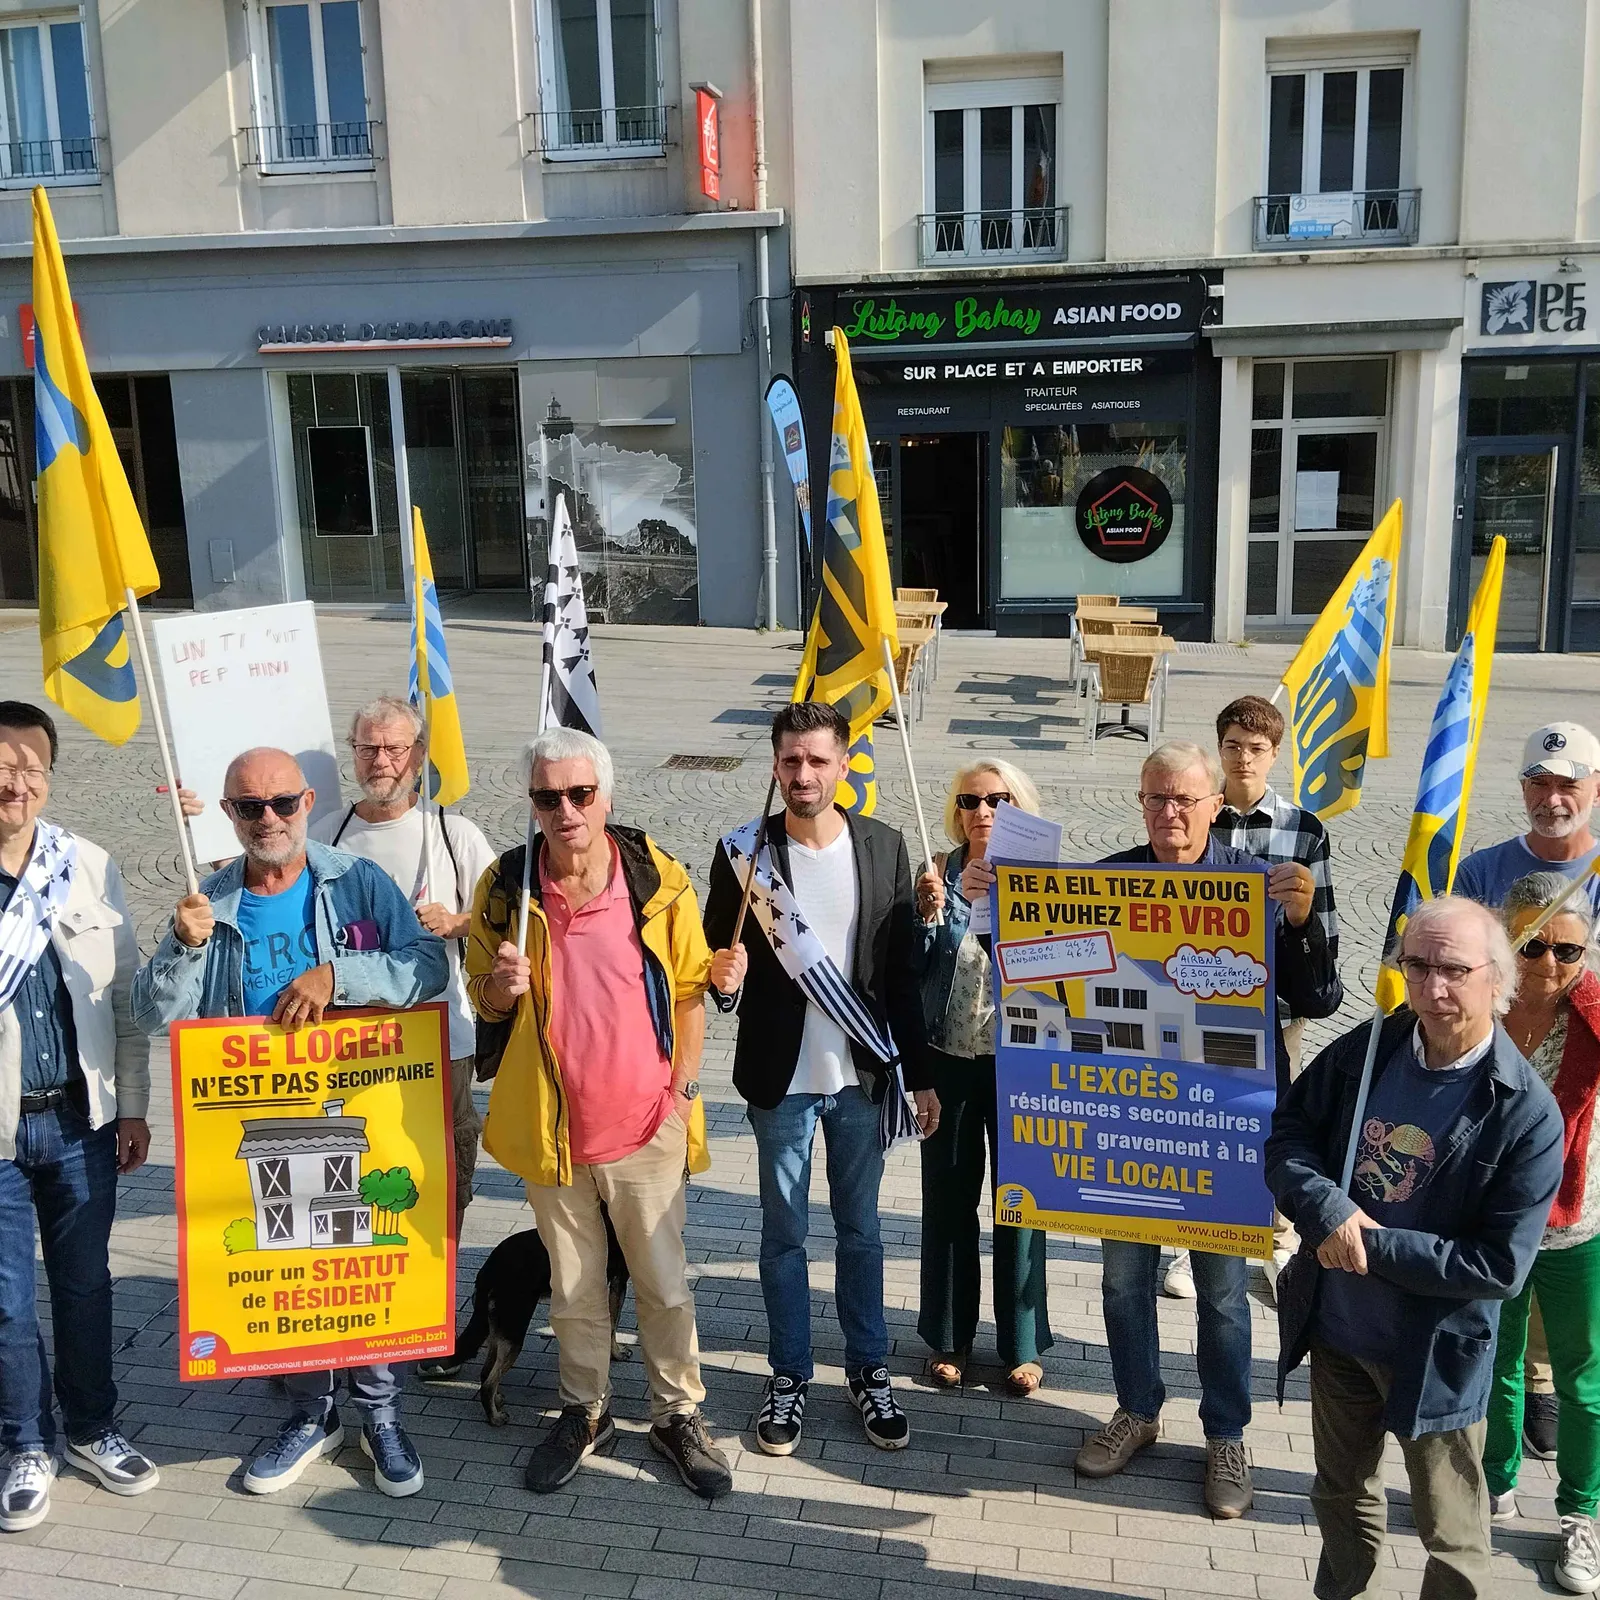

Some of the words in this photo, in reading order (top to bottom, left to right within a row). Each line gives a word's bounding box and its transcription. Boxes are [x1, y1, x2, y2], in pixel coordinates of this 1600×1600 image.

[846, 300, 945, 340] Lutong
[955, 297, 1042, 340] Bahay
[1053, 304, 1115, 325] ASIAN
[1121, 302, 1181, 322] FOOD
[256, 323, 347, 344] CAISSE
[903, 366, 936, 381] SUR
[945, 362, 997, 379] PLACE
[1005, 362, 1025, 377] ET
[1033, 361, 1045, 376] A
[1053, 358, 1143, 375] EMPORTER
[1024, 386, 1077, 398] TRAITEUR
[897, 406, 951, 416] RESTAURANT
[1024, 400, 1083, 412] SPECIALITÉES
[1091, 400, 1141, 411] ASIATIQUES
[1084, 507, 1125, 529] Lutong
[1129, 503, 1165, 530] Bahay
[171, 638, 206, 663] UN
[219, 632, 246, 652] TI
[189, 667, 229, 687] PEP
[248, 660, 289, 677] HINI
[1008, 874, 1039, 894] RE
[1044, 875, 1060, 895] A
[1066, 876, 1101, 896] EIL
[1105, 877, 1156, 898] TIEZ
[1162, 880, 1178, 899] A
[1183, 879, 1250, 903] VOUG
[1009, 901, 1040, 923] AR
[1046, 903, 1121, 927] VUHEZ
[1129, 902, 1172, 934] ER
[1180, 905, 1250, 938] VRO
[1181, 980, 1200, 988] dans
[1205, 978, 1216, 989] le
[1220, 976, 1265, 988] Finistère
[222, 1034, 270, 1068] SE
[286, 1022, 404, 1066] LOGER
[192, 1074, 264, 1098] N'EST
[272, 1071, 319, 1094] PAS
[327, 1062, 434, 1089] SECONDAIRE
[1051, 1063, 1179, 1100] L'EXCÈS
[1189, 1084, 1215, 1103] de
[1009, 1091, 1121, 1118] résidences
[1128, 1106, 1261, 1133] secondaires
[1012, 1114, 1088, 1150] NUIT
[1097, 1131, 1210, 1159] gravement
[1217, 1140, 1230, 1161] à
[1238, 1143, 1258, 1164] la
[1052, 1152, 1095, 1182] VIE
[1106, 1158, 1213, 1196] LOCALE
[1000, 1209, 1022, 1224] UDB
[1024, 1218, 1047, 1227] UNION
[1049, 1220, 1103, 1235] DÉMOCRATIQUE
[1104, 1228, 1141, 1240] BRETONNE
[1151, 1234, 1191, 1246] UNVANIEZH
[1192, 1240, 1239, 1253] DEMOKRATEL
[1241, 1246, 1265, 1256] BREIZH
[1177, 1224, 1265, 1244] www.udb.bzh
[228, 1266, 274, 1287] pour
[281, 1266, 305, 1281] un
[312, 1253, 409, 1282] STATUT
[242, 1293, 266, 1309] de
[274, 1281, 396, 1312] RÉSIDENT
[247, 1318, 269, 1334] en
[277, 1311, 376, 1335] Bretagne
[365, 1331, 447, 1348] www.udb.bzh
[188, 1359, 216, 1376] UDB
[248, 1362, 301, 1372] DÉMOCRATIQUE
[303, 1357, 337, 1367] BRETONNE
[346, 1353, 382, 1362] UNVANIEZH
[383, 1348, 425, 1358] DEMOKRATEL
[426, 1345, 448, 1353] BREIZH
